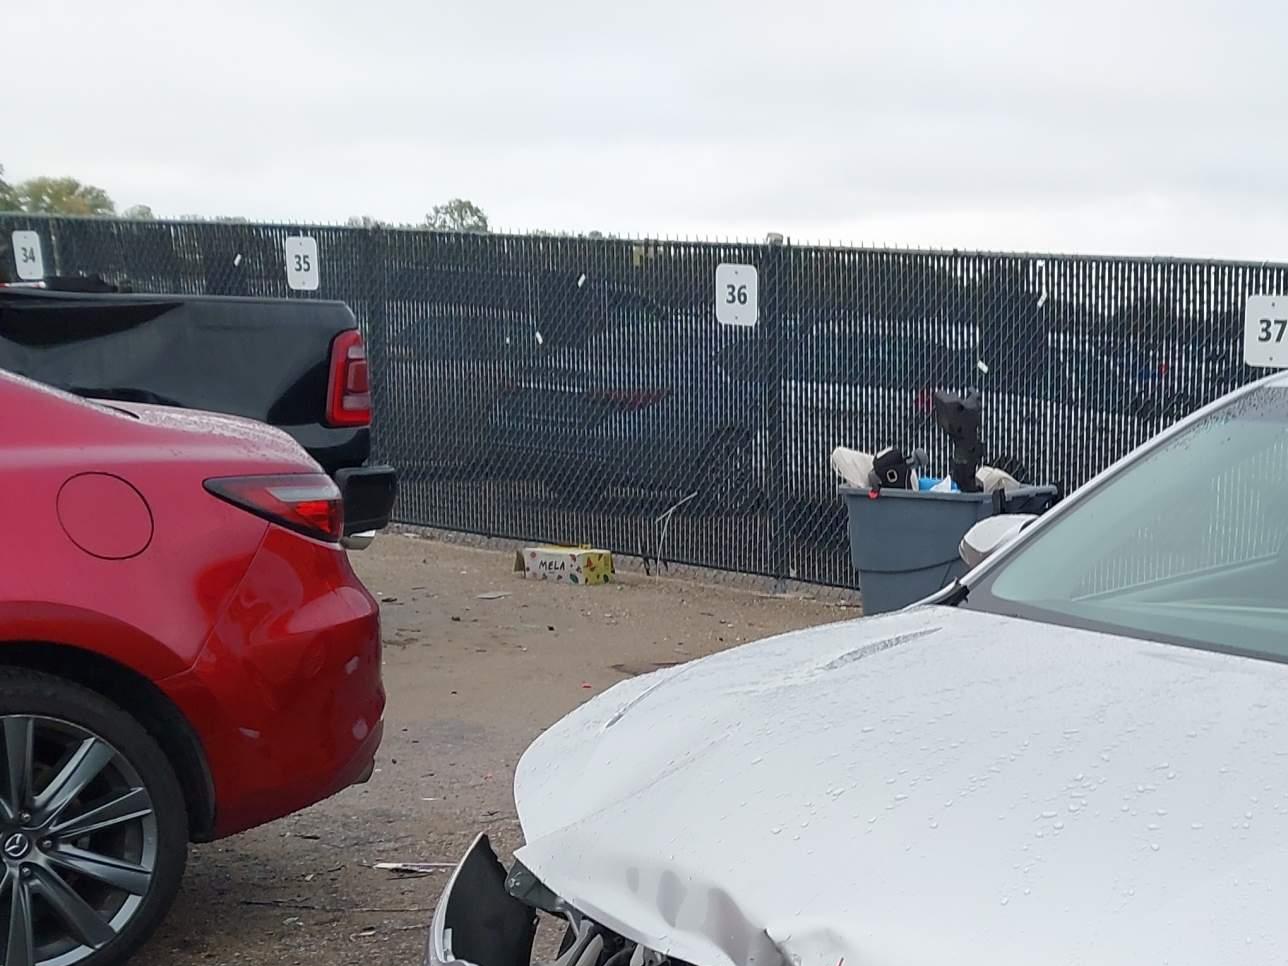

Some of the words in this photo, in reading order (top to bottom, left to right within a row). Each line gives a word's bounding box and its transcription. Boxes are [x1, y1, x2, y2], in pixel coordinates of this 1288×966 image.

[21, 247, 36, 263] 34
[294, 254, 311, 273] 35
[726, 284, 748, 305] 36
[1258, 319, 1288, 343] 37
[539, 559, 565, 571] MELA
